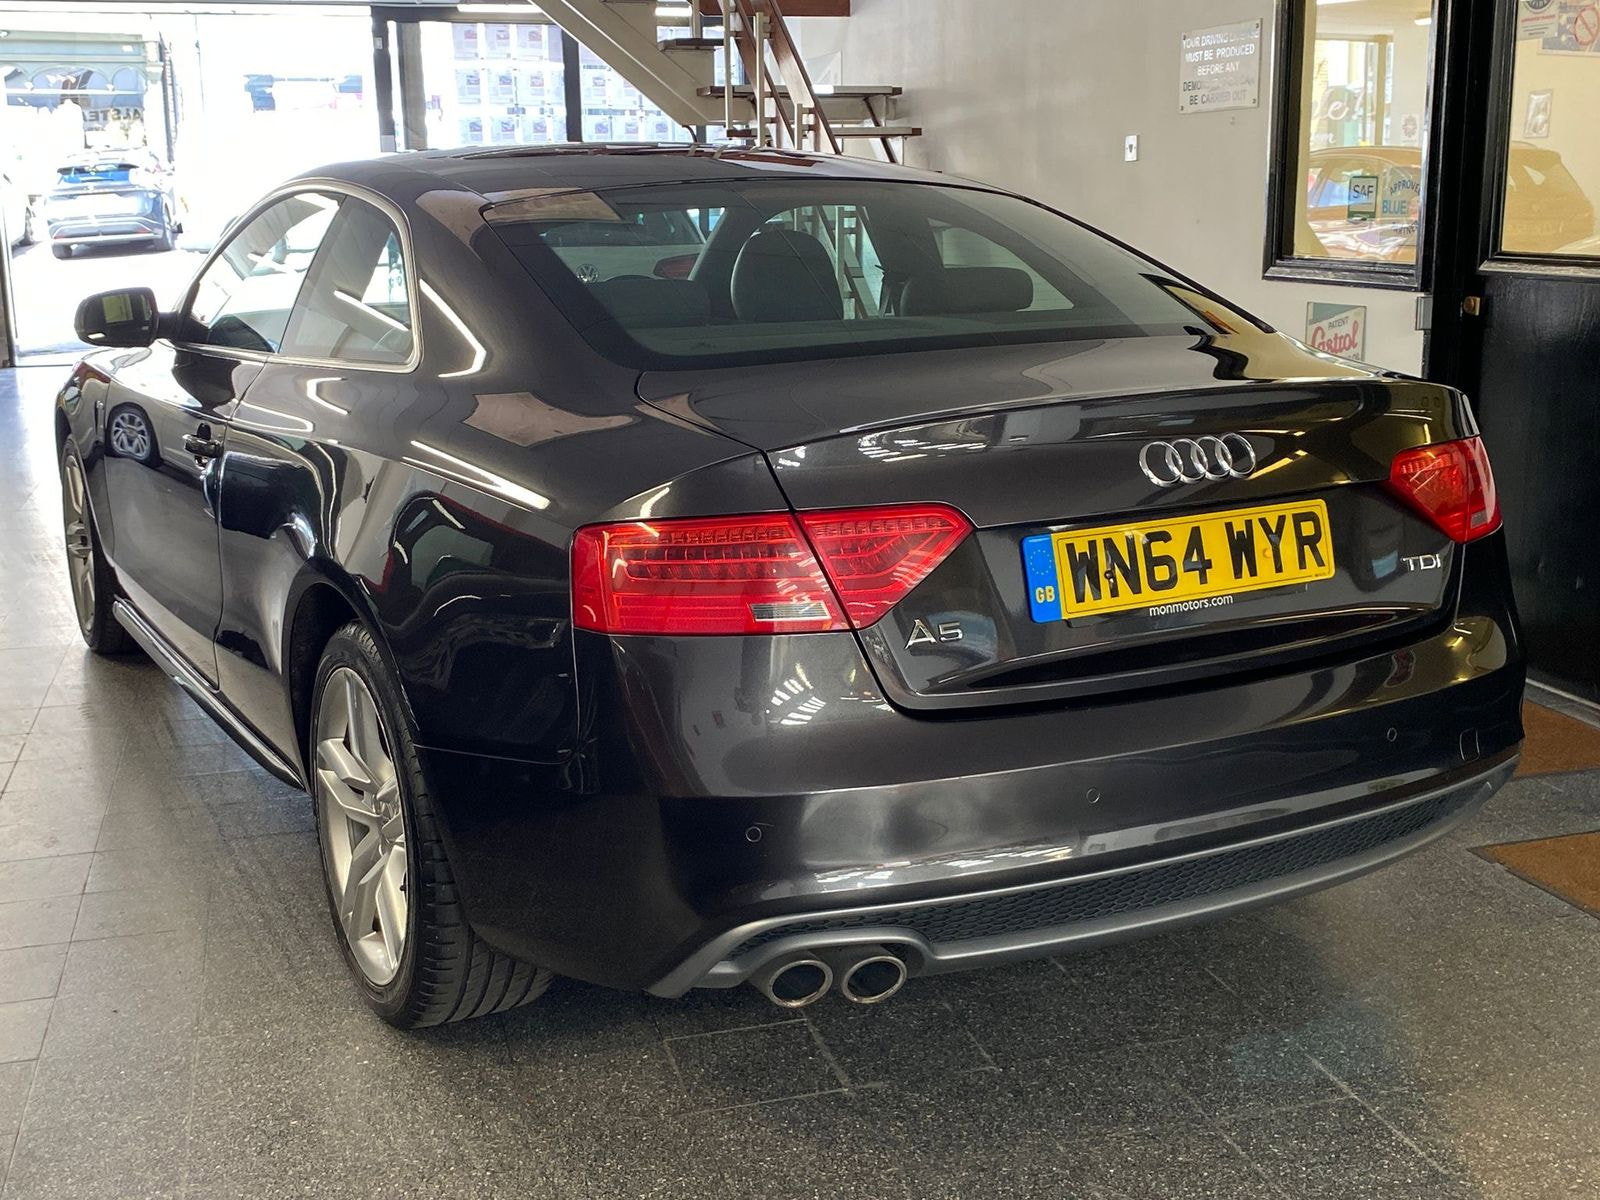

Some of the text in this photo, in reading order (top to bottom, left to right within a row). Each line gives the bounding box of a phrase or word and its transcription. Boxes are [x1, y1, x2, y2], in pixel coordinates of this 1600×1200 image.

[1183, 36, 1201, 49] YOUR
[1201, 32, 1229, 47] DRIVING
[1185, 43, 1255, 63] MUST BE PRODUCED
[1197, 61, 1240, 76] BEFORE ANY
[1189, 95, 1199, 105] BE
[1352, 183, 1374, 199] SAF
[1064, 510, 1327, 606] WN64 WYR
[1401, 553, 1441, 571] TDI
[1034, 584, 1056, 605] GB
[1148, 593, 1235, 618] monmotors.com
[904, 618, 964, 650] A5
